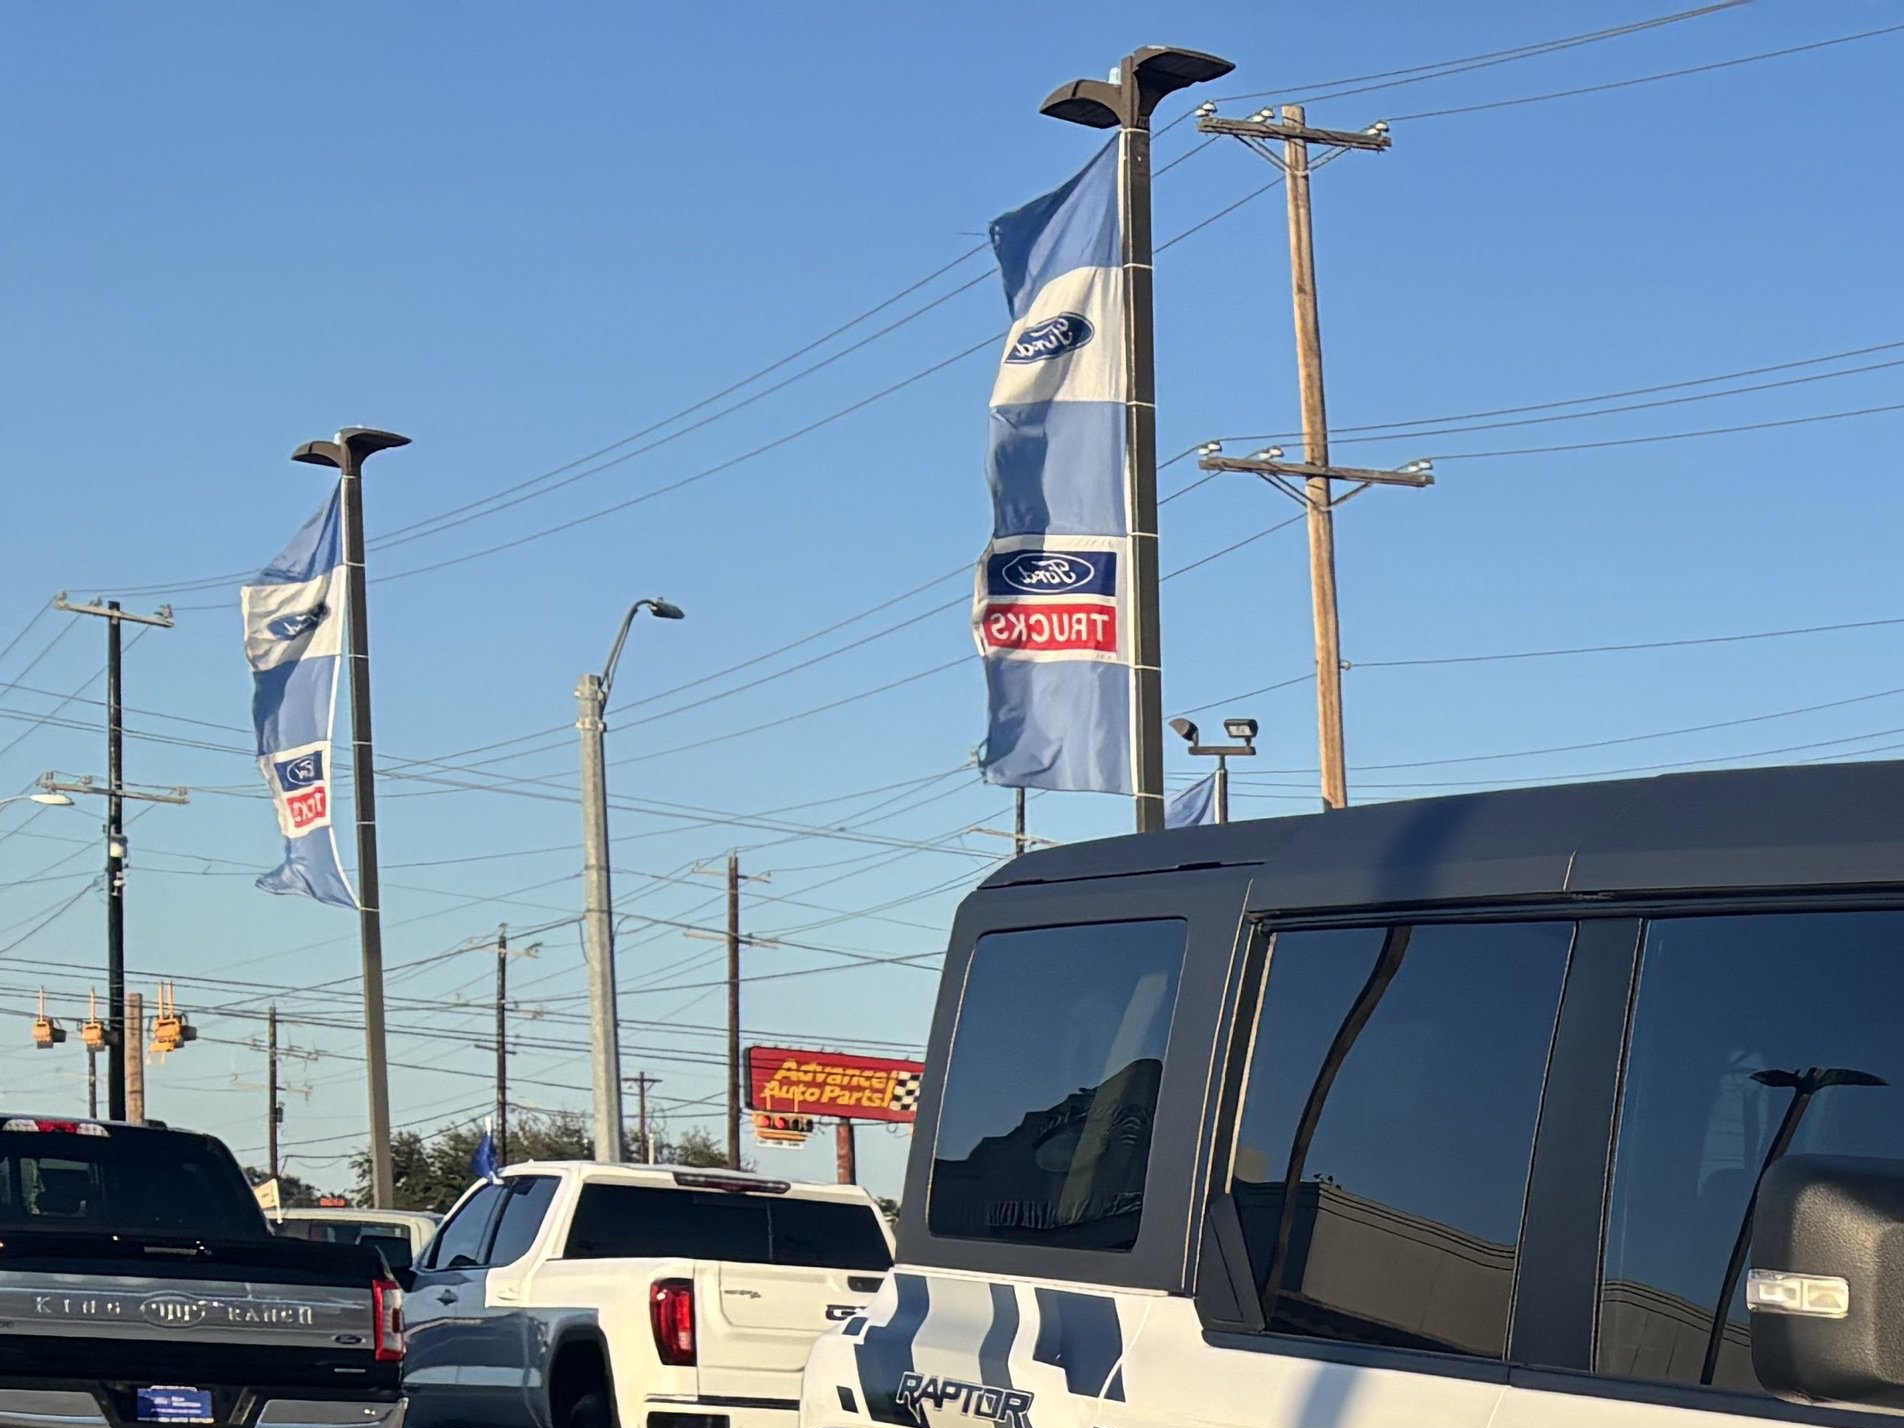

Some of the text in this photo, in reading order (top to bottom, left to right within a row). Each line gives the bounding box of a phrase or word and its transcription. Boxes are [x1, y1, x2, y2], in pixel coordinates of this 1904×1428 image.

[773, 1058, 888, 1089] Advance
[762, 1080, 884, 1108] Auto Parts
